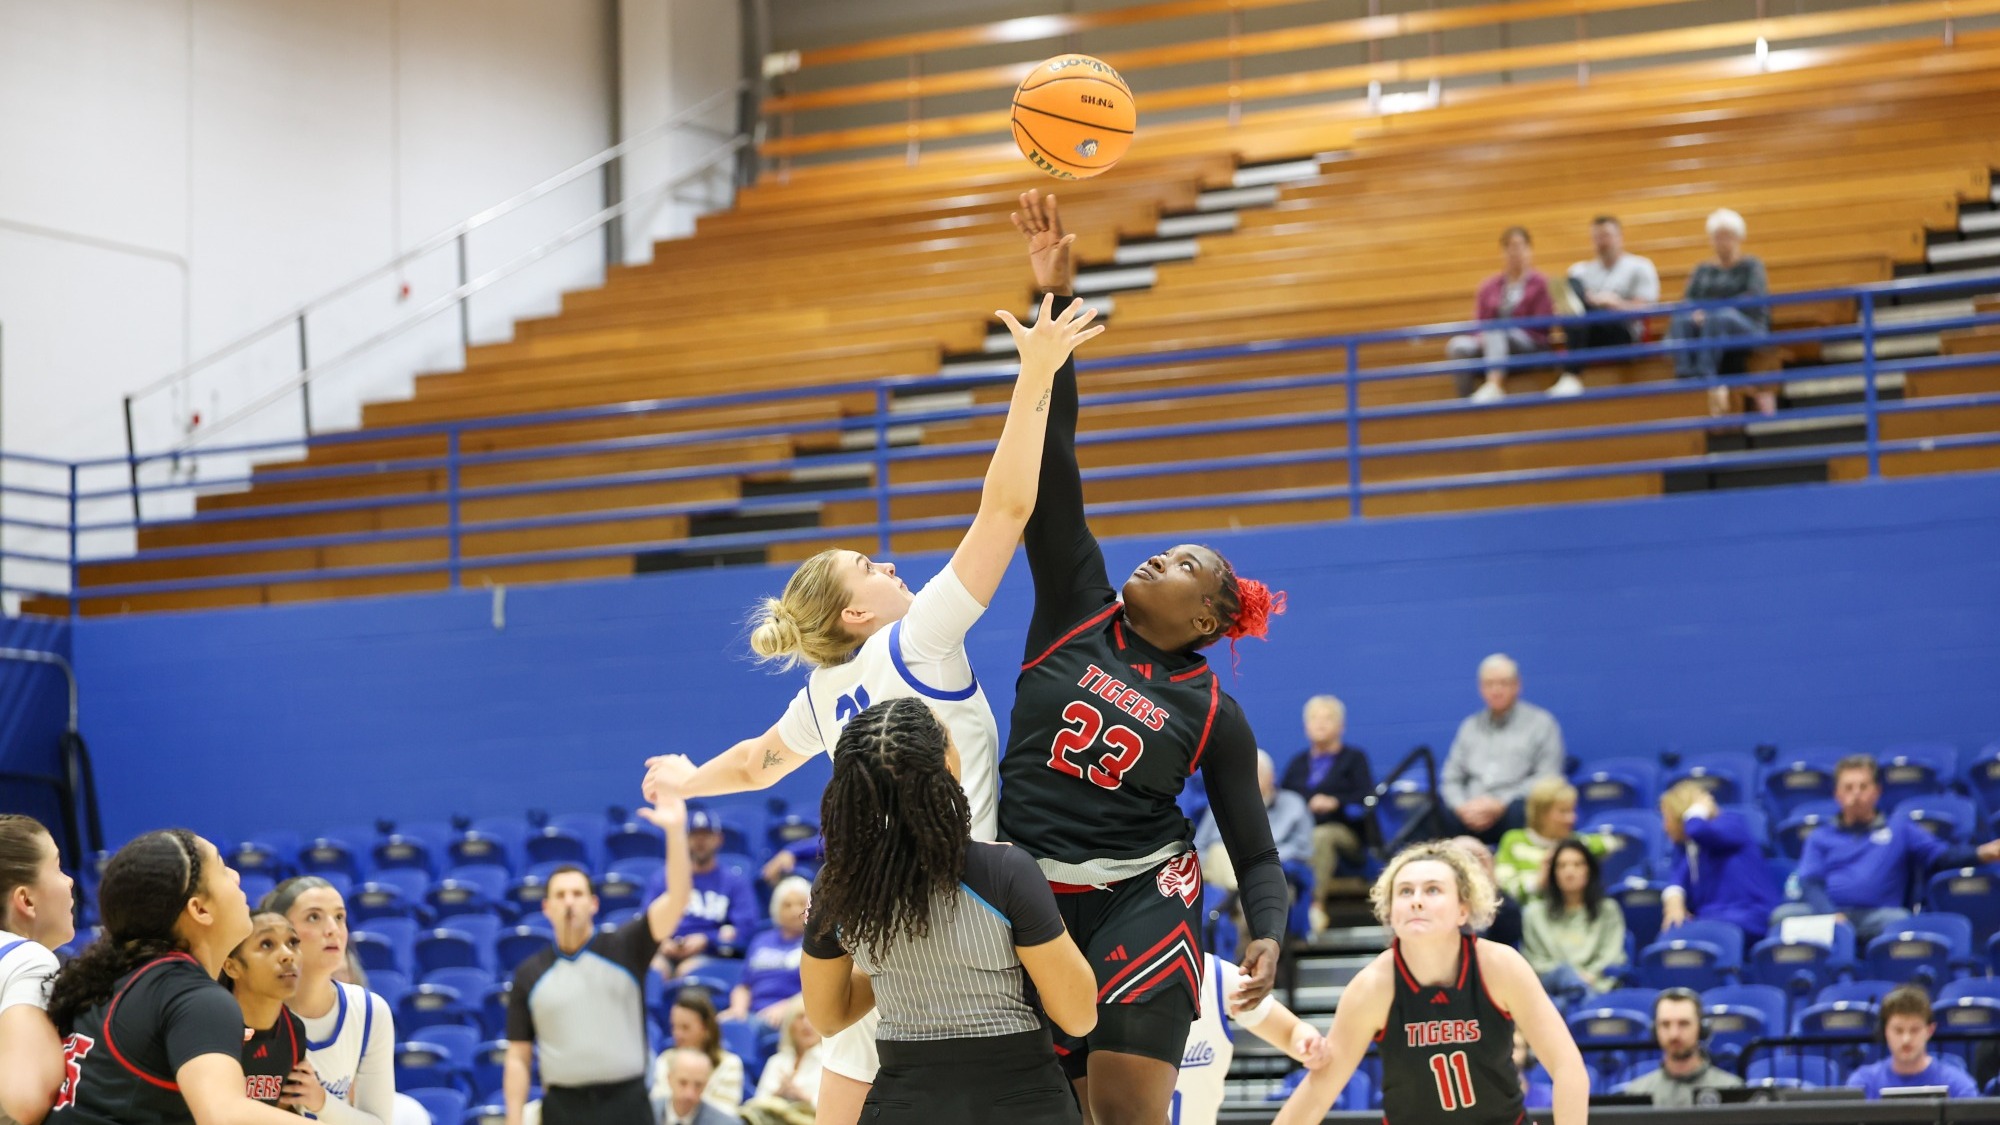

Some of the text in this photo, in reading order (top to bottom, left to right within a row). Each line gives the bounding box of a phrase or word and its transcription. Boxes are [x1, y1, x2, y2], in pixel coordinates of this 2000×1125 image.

[1077, 663, 1170, 732] TIGERS
[1046, 700, 1144, 791] 23
[1404, 1019, 1482, 1048] TIGERS
[1429, 1050, 1477, 1112] 11
